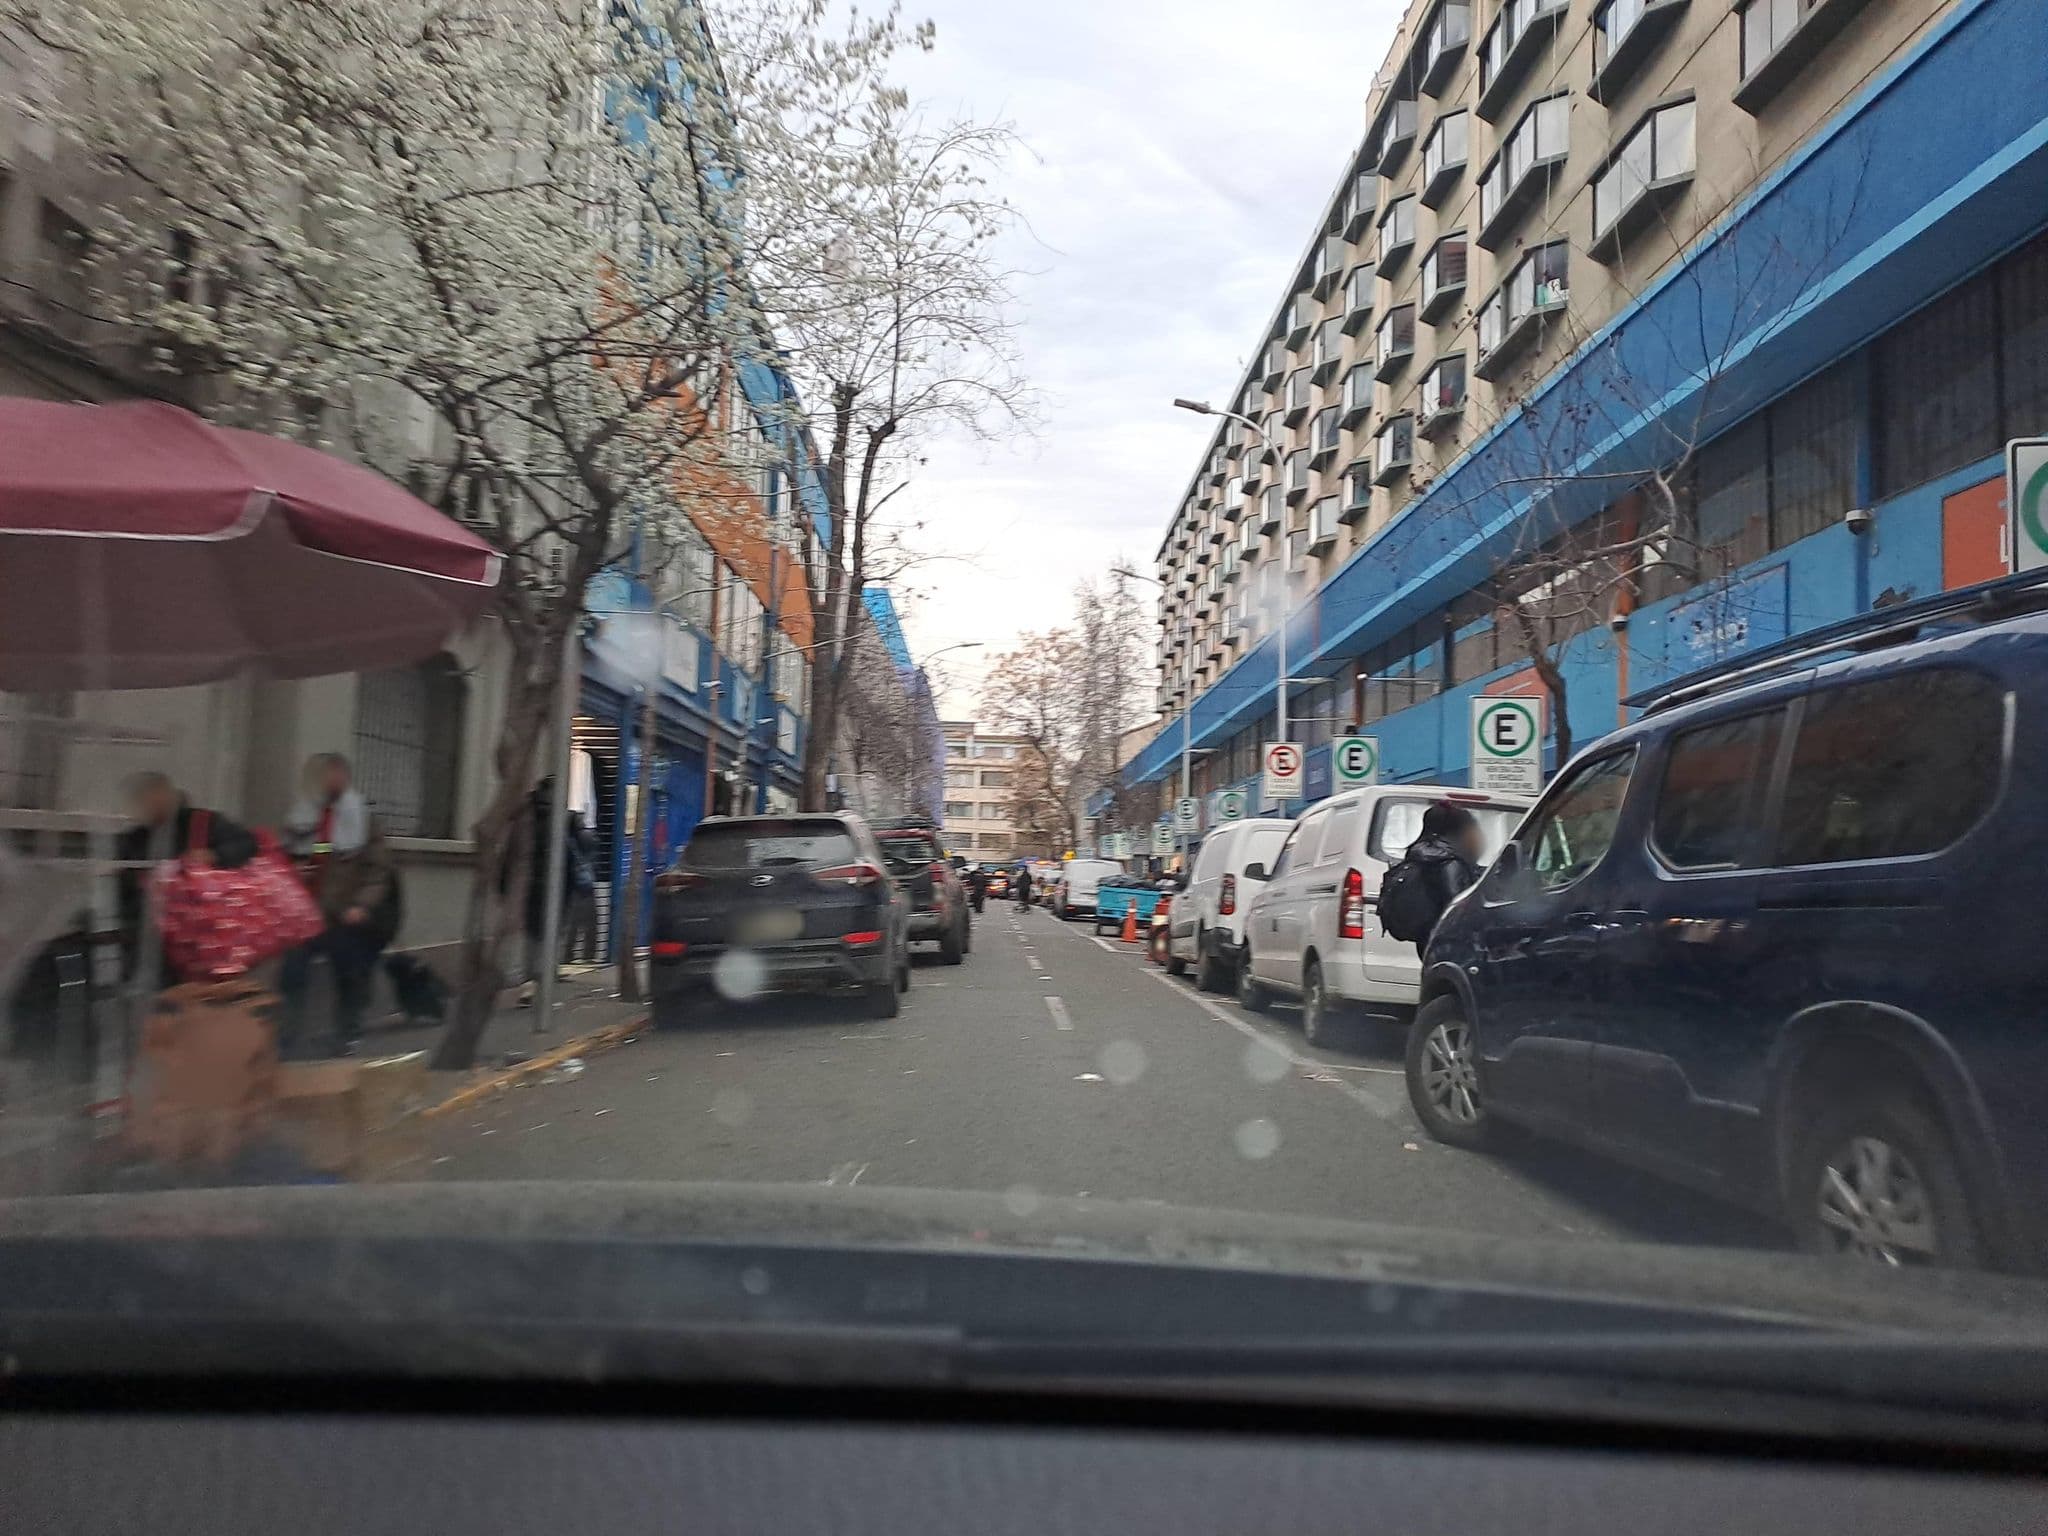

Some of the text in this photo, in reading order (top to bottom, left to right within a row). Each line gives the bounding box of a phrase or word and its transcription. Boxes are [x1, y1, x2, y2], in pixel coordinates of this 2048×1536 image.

[1495, 714, 1517, 745] E
[1278, 751, 1289, 770] E
[1348, 747, 1363, 771] E
